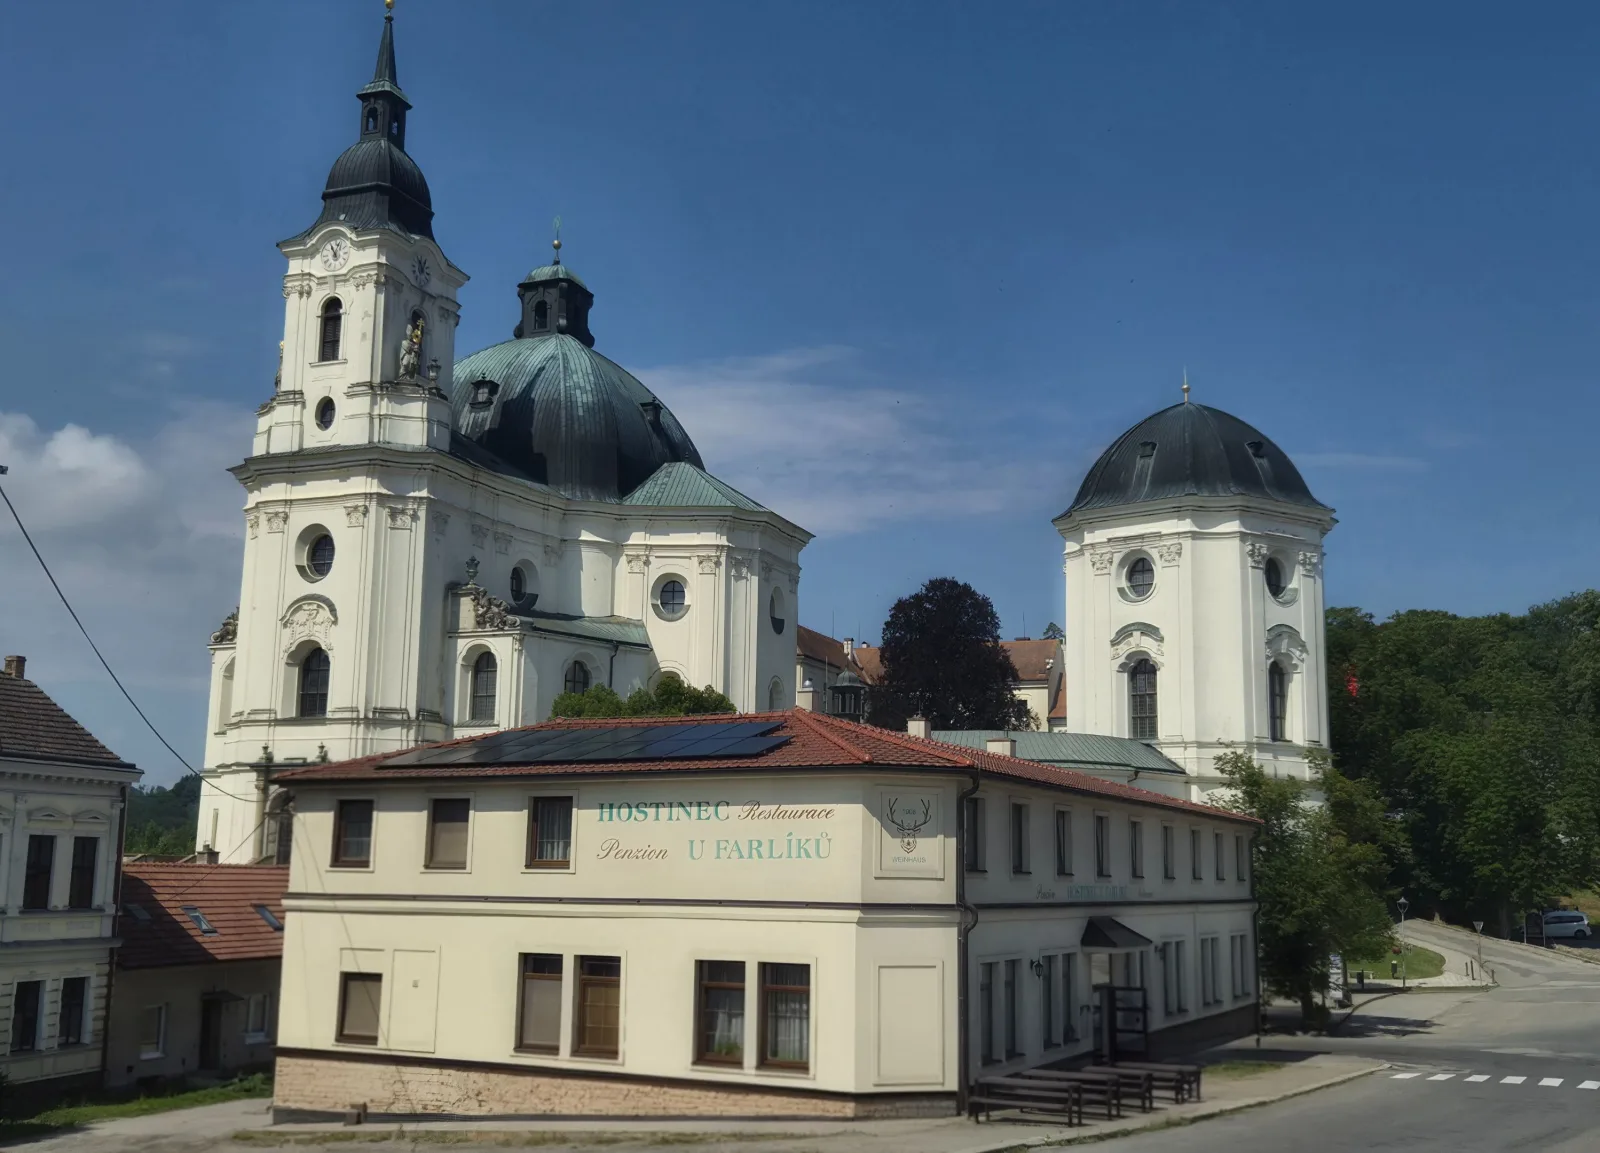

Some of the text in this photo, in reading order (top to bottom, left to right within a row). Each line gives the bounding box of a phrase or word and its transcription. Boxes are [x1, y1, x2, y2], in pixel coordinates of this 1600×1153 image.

[597, 801, 730, 822] HOSTINEC
[738, 800, 835, 821] Restaurace
[597, 838, 668, 860] Penzion
[688, 831, 833, 861] U FARLÍKŮ
